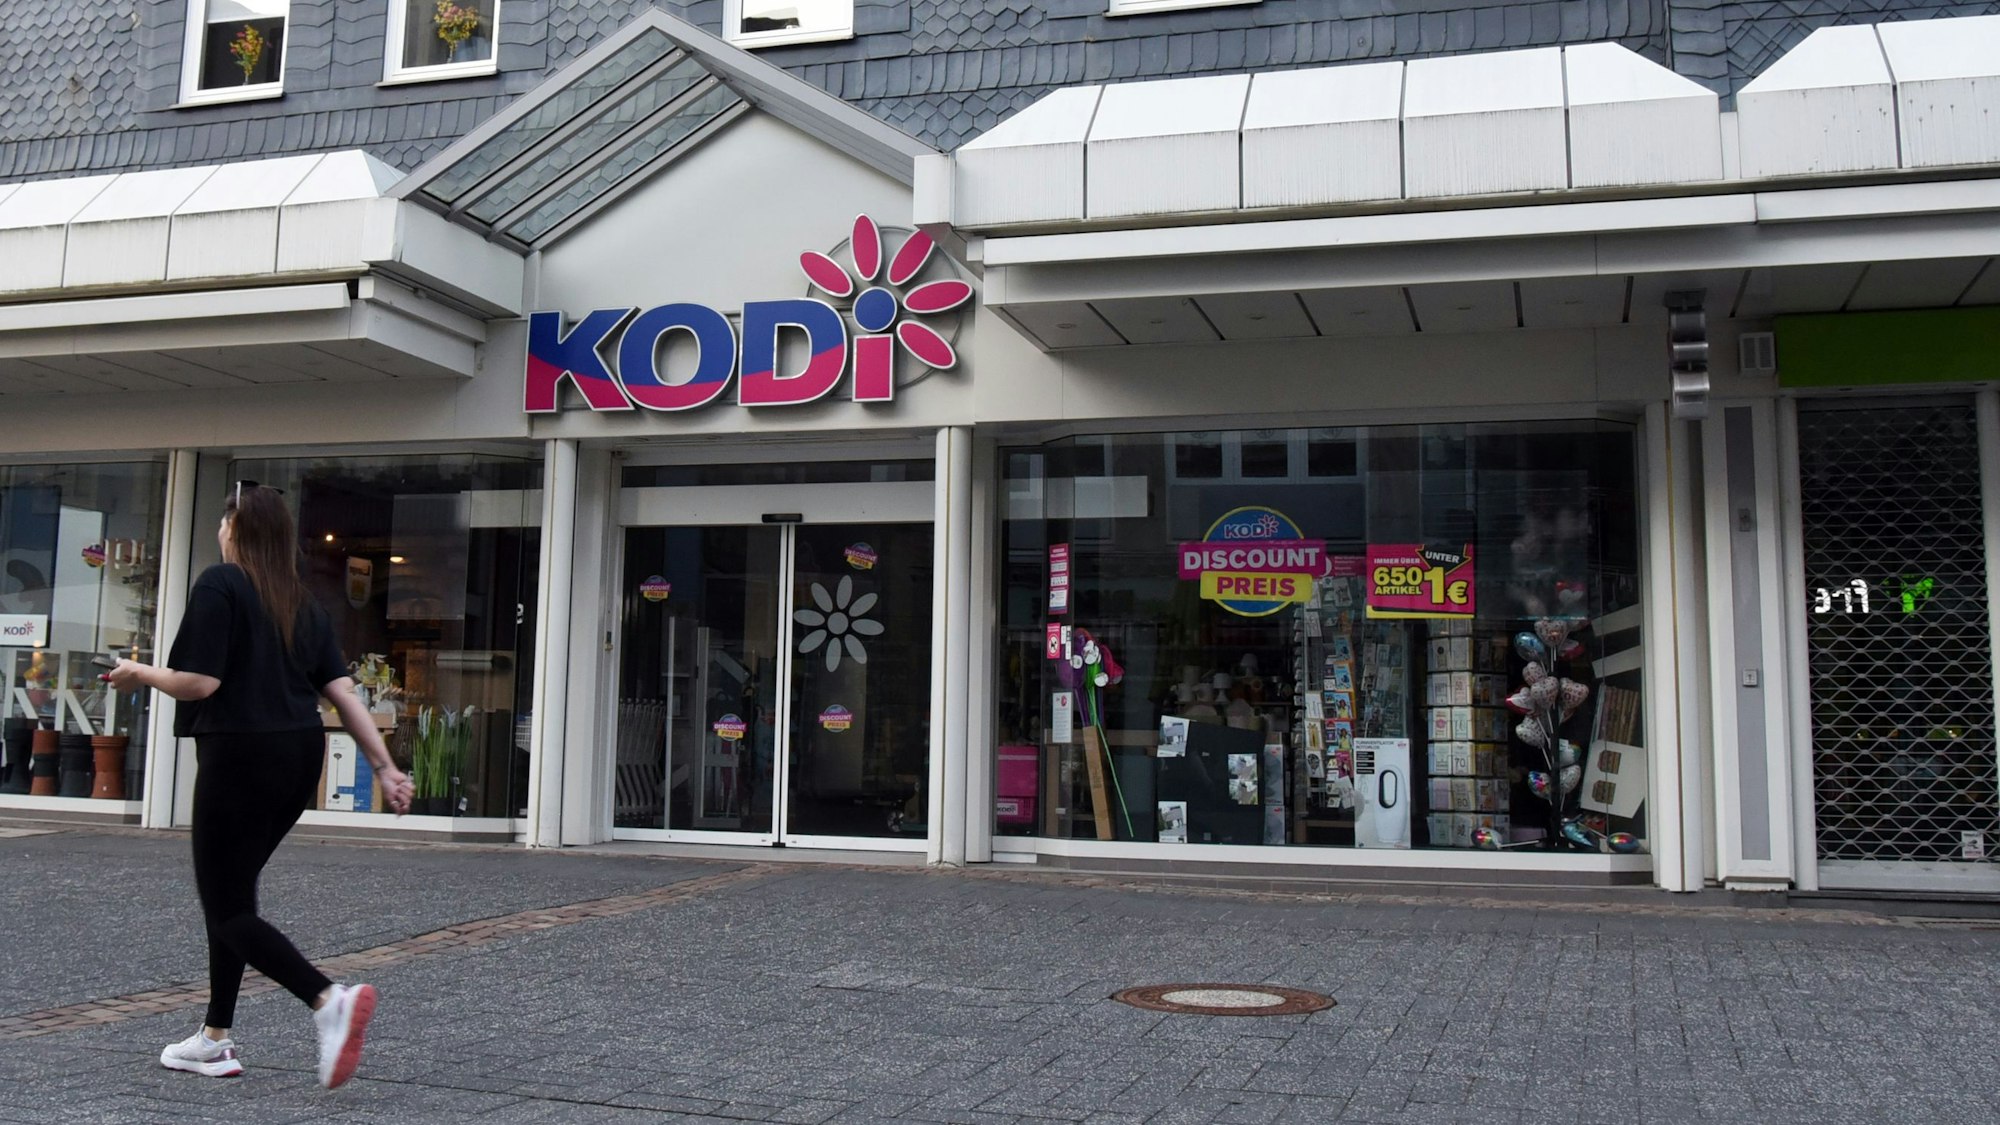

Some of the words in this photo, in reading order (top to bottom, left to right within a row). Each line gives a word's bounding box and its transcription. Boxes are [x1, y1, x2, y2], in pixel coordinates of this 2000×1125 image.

[1184, 547, 1321, 571] DISCOUNT
[1374, 557, 1399, 565] IMMER
[1400, 556, 1421, 565] ÜBER
[1425, 551, 1460, 564] UNTER
[1373, 566, 1423, 586] 650
[1217, 576, 1296, 597] PREIS
[1374, 586, 1422, 595] ARTIKEL
